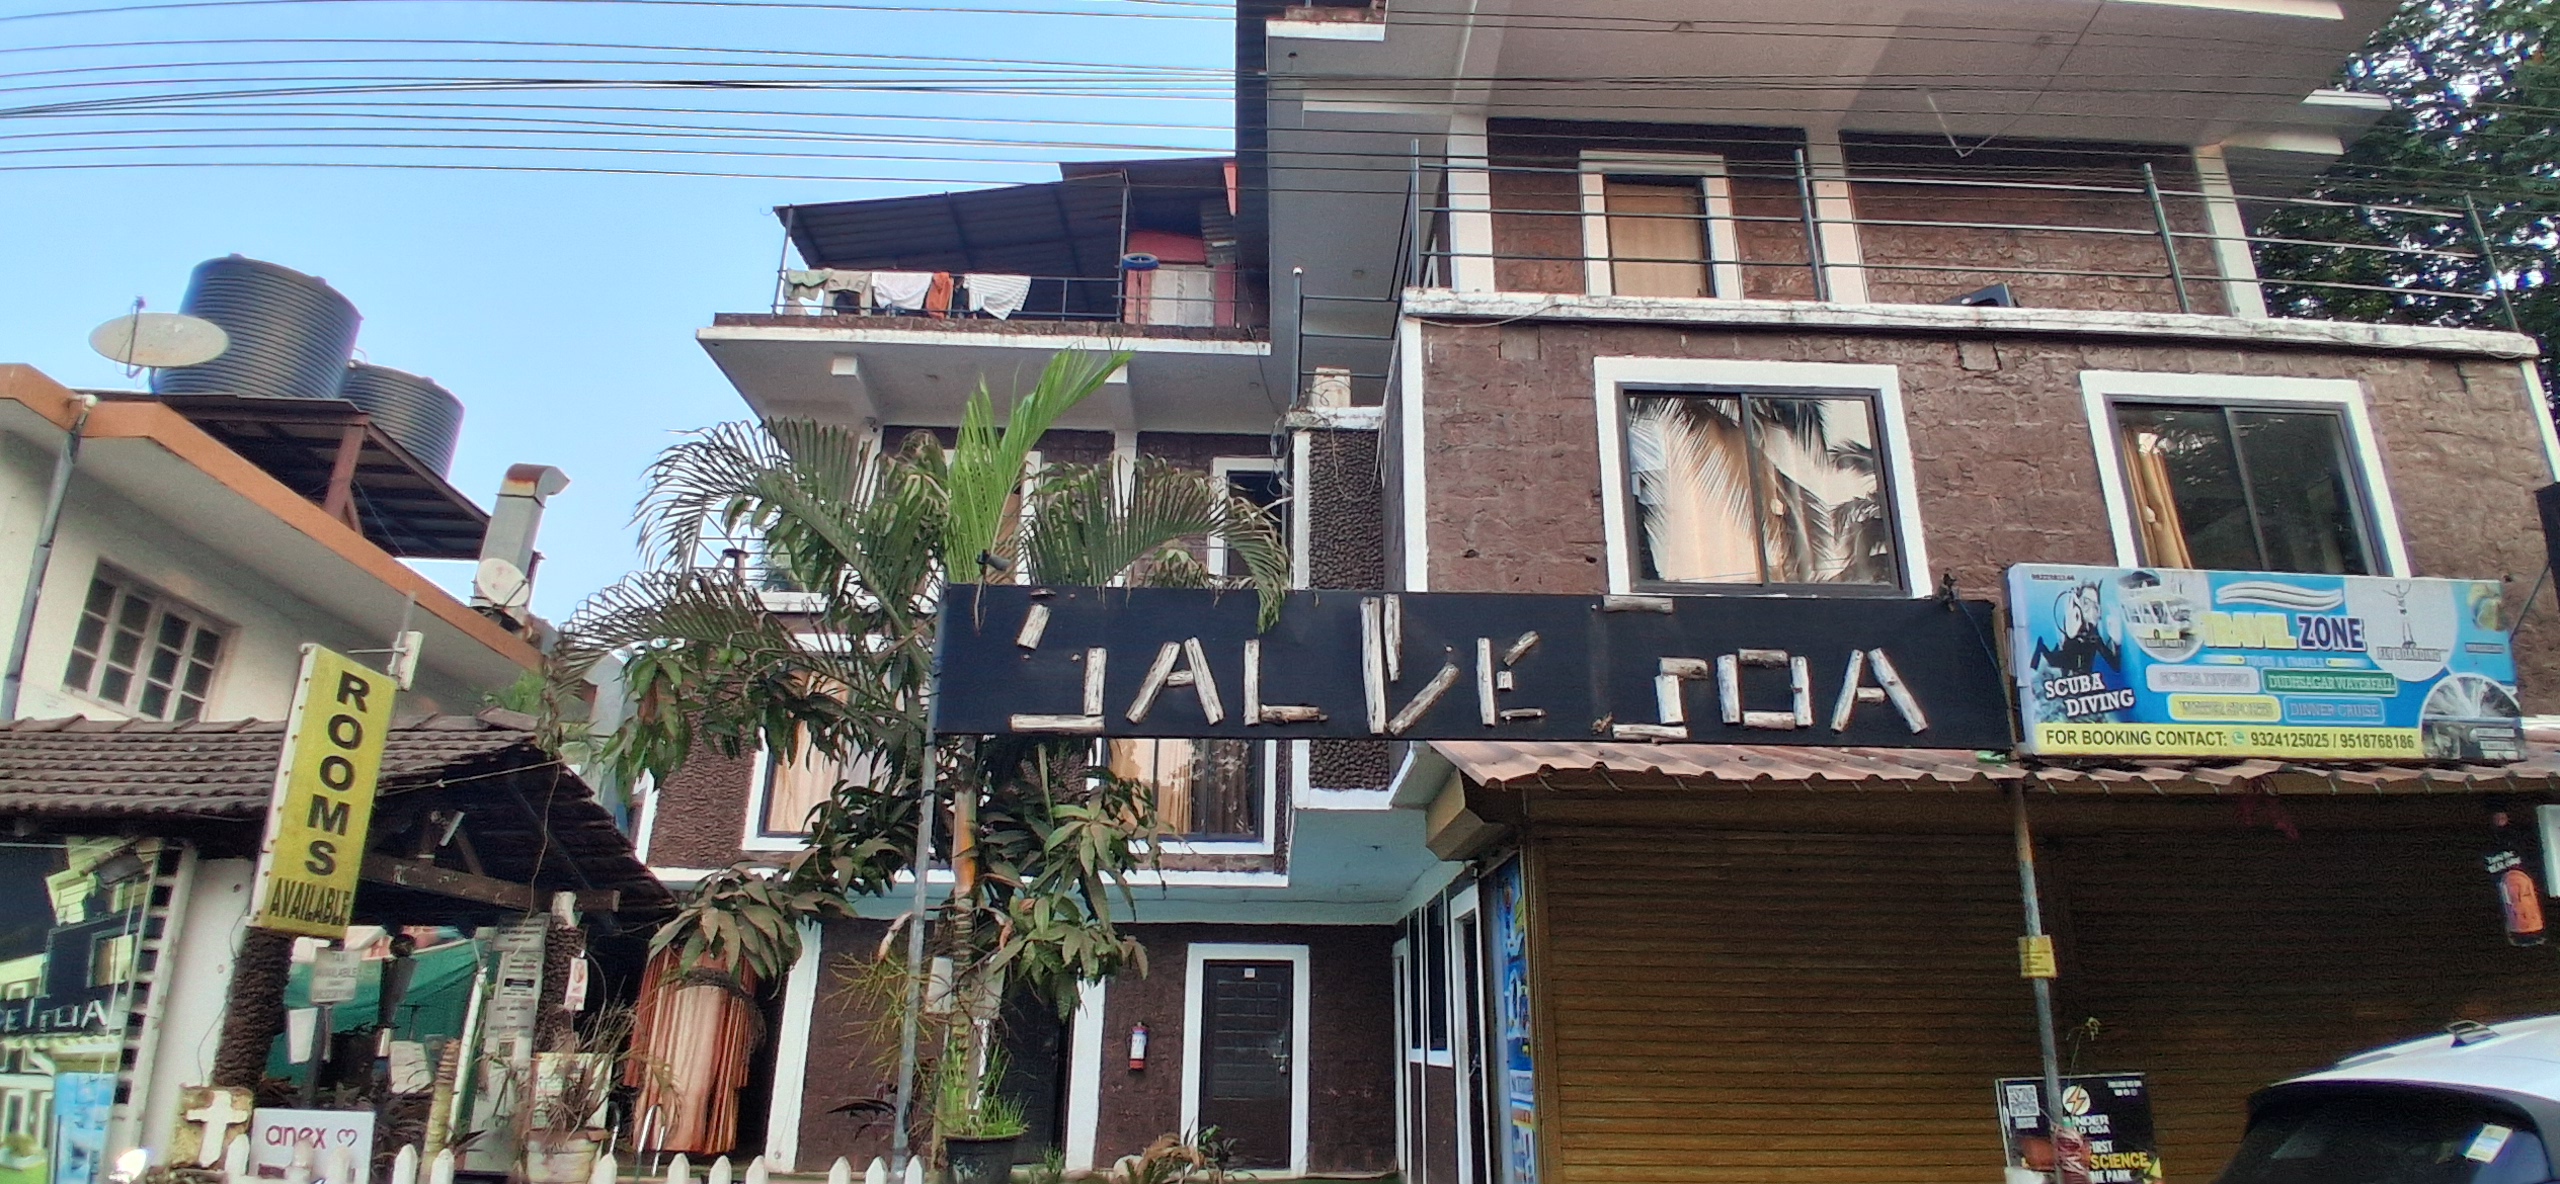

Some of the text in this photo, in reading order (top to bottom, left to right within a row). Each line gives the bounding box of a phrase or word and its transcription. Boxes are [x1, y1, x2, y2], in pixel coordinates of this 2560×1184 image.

[2298, 615, 2367, 651] ZONE
[2044, 672, 2106, 699] SCUBA
[2336, 677, 2396, 691] WATERFALL
[2064, 688, 2136, 718] DIVING
[2290, 703, 2381, 718] DINNER CRUISE
[2046, 729, 2078, 745] FOR
[2082, 730, 2151, 746] BOOKING
[2155, 731, 2228, 747] CONTACT:
[2250, 732, 2330, 747] 9324125025
[2340, 733, 2415, 749] 9518768186
[304, 669, 371, 876] ROOMS
[268, 877, 353, 926] AVAILABLE
[265, 1124, 327, 1150] anex
[2090, 1152, 2151, 1170] SCIENCE
[2106, 1170, 2132, 1183] PARK
